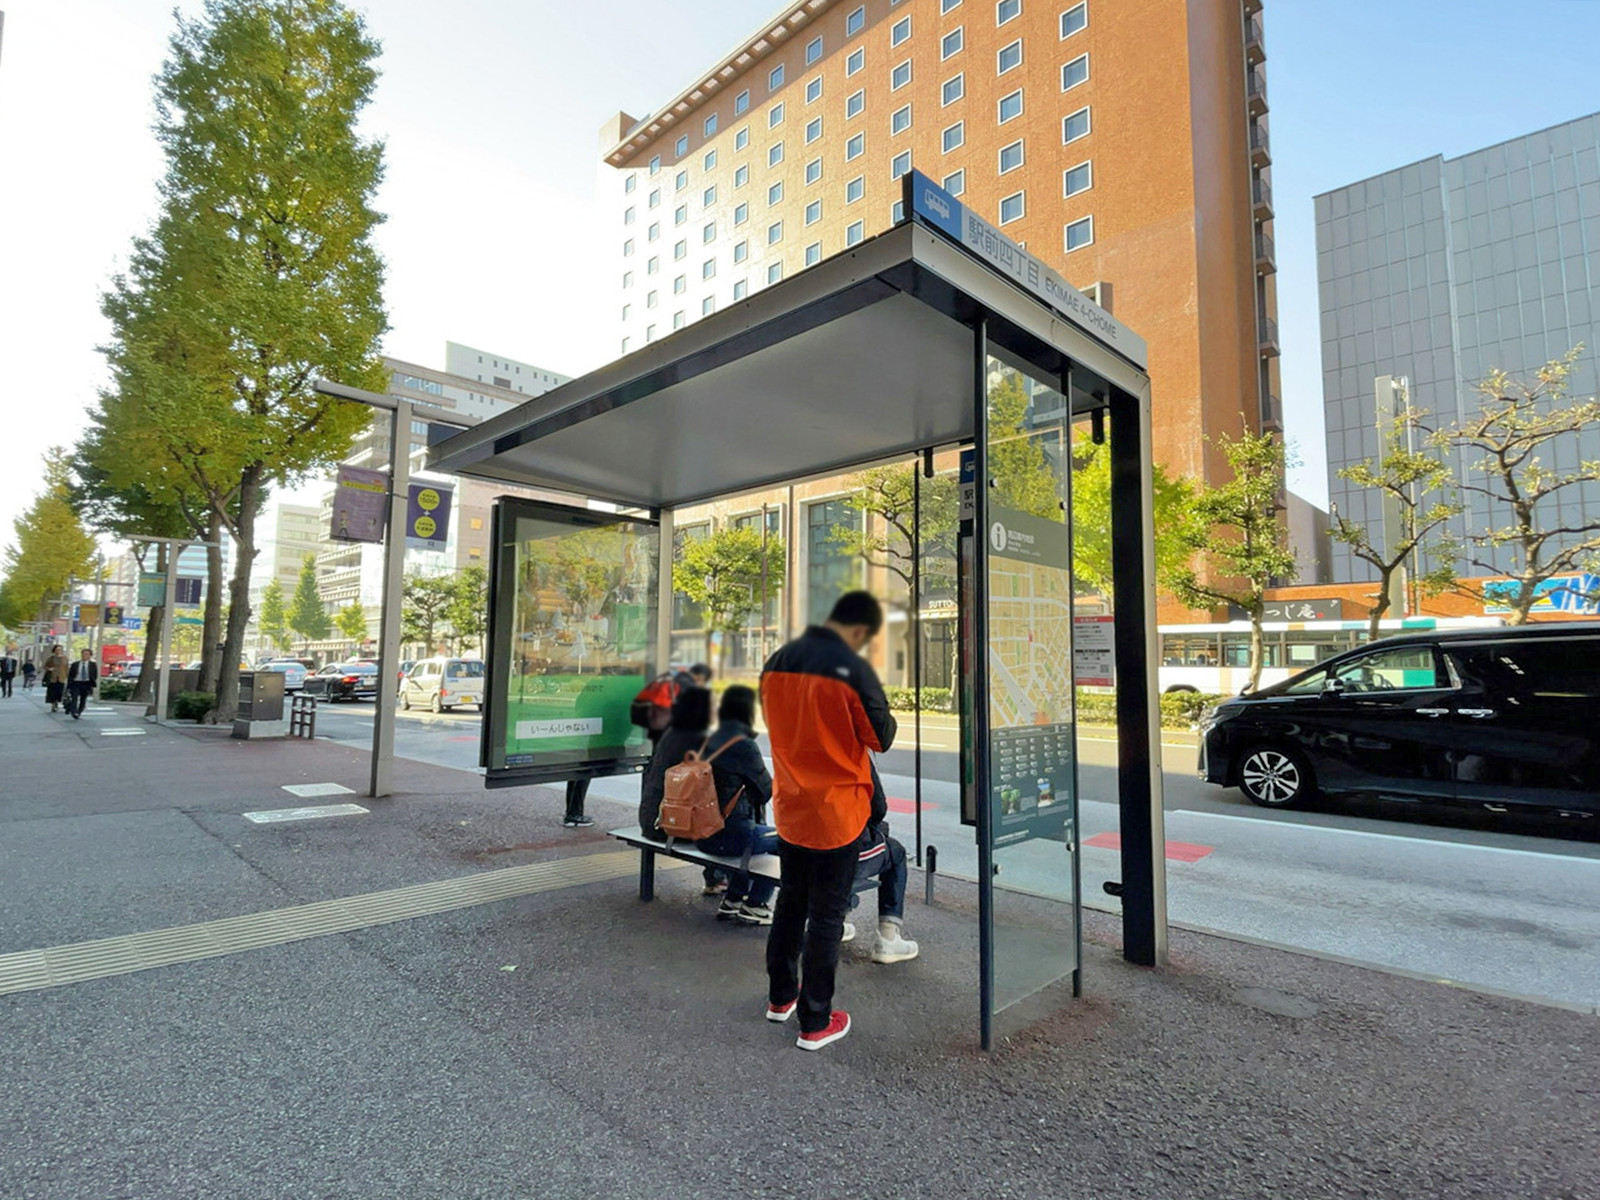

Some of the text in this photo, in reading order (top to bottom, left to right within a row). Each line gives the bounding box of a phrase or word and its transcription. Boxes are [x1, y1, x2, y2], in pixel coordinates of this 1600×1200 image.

[969, 215, 1039, 288] 駅前四丁目
[1045, 276, 1117, 340] EKIMAE 4-CHOME
[1247, 603, 1316, 620] つじ庵
[530, 722, 590, 735] いーんじゃない
